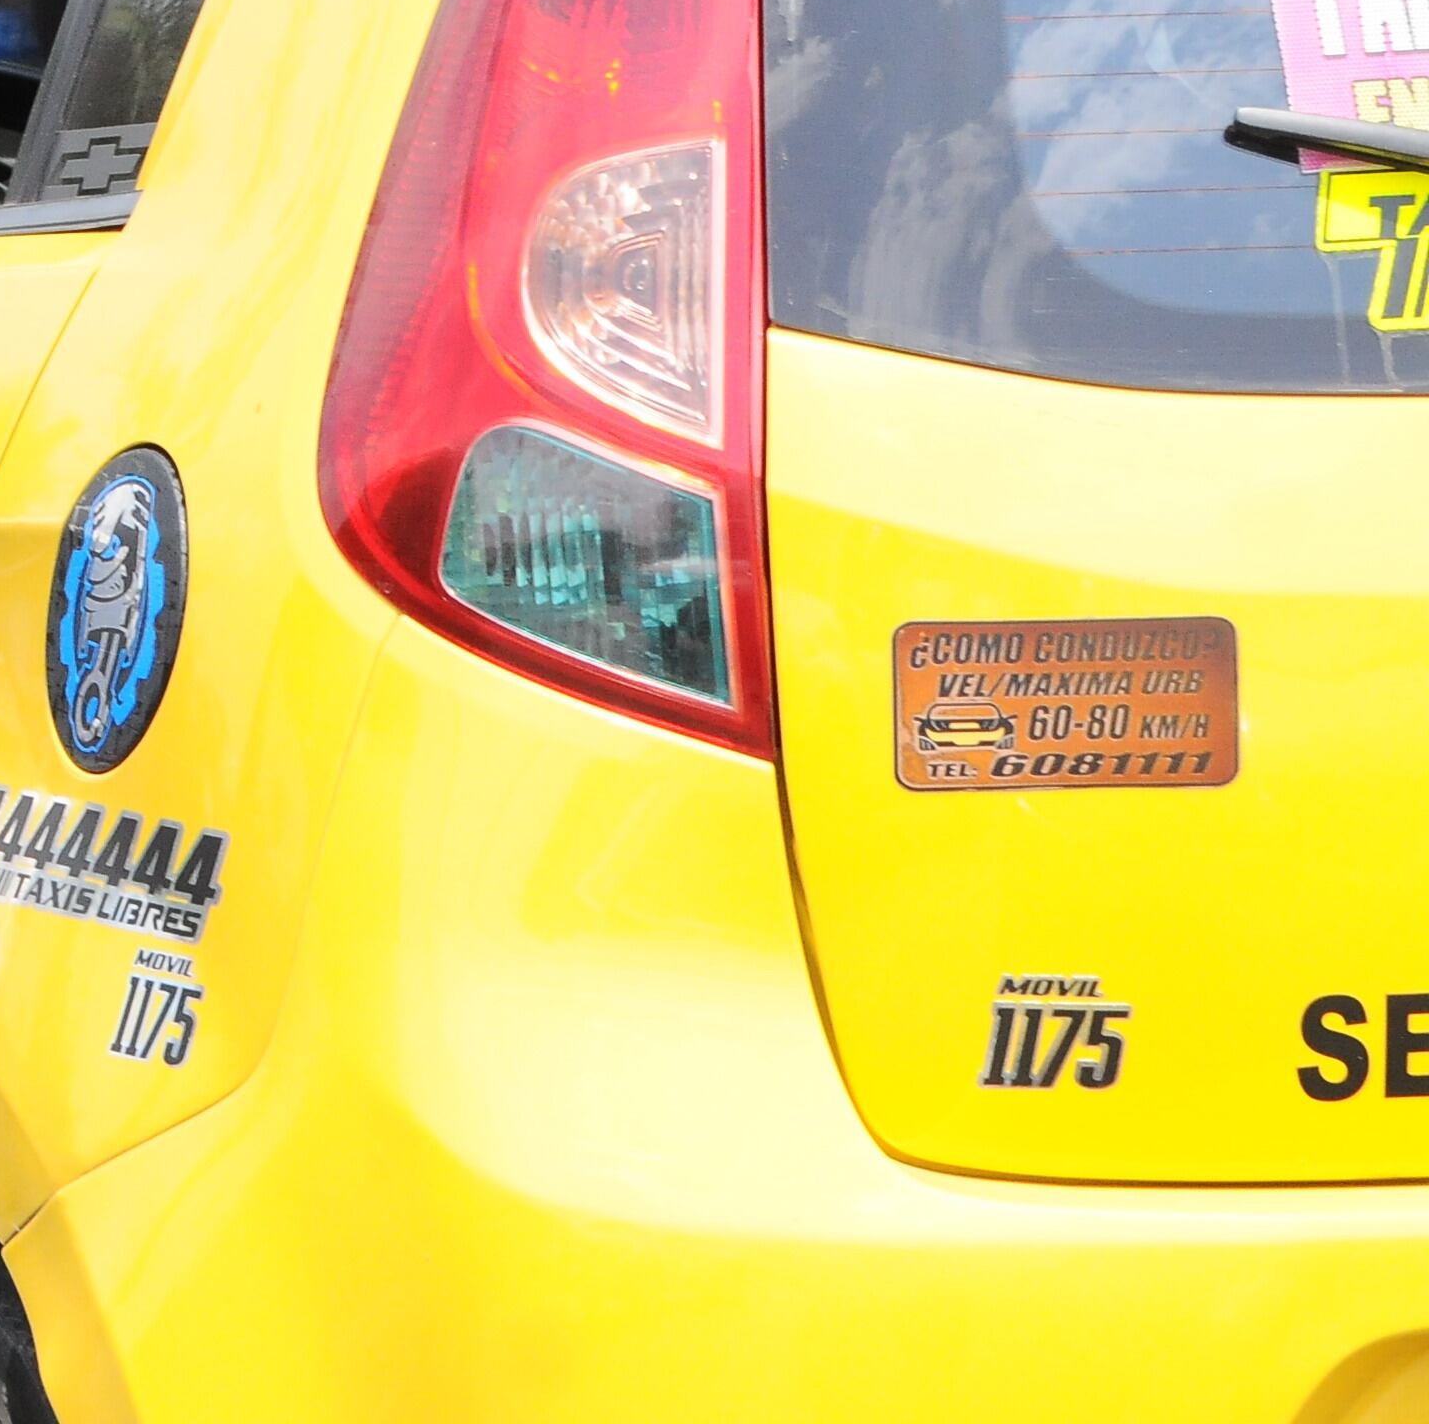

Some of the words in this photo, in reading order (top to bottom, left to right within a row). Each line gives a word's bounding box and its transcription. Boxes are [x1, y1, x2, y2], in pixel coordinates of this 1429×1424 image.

[910, 632, 1025, 669] ¿COMO
[938, 672, 1133, 698] VEL/MAXIMA
[1140, 669, 1206, 695] URB
[1028, 704, 1131, 741] 60-80
[1138, 713, 1210, 740] KM/H
[990, 751, 1212, 778] 6081111
[13, 872, 95, 915] TAXIS
[96, 891, 203, 938] LIBRES
[134, 949, 194, 977] MOVIL
[998, 977, 1103, 998] MOVIL
[110, 975, 202, 1065] 1175
[982, 1007, 1130, 1089] 1175
